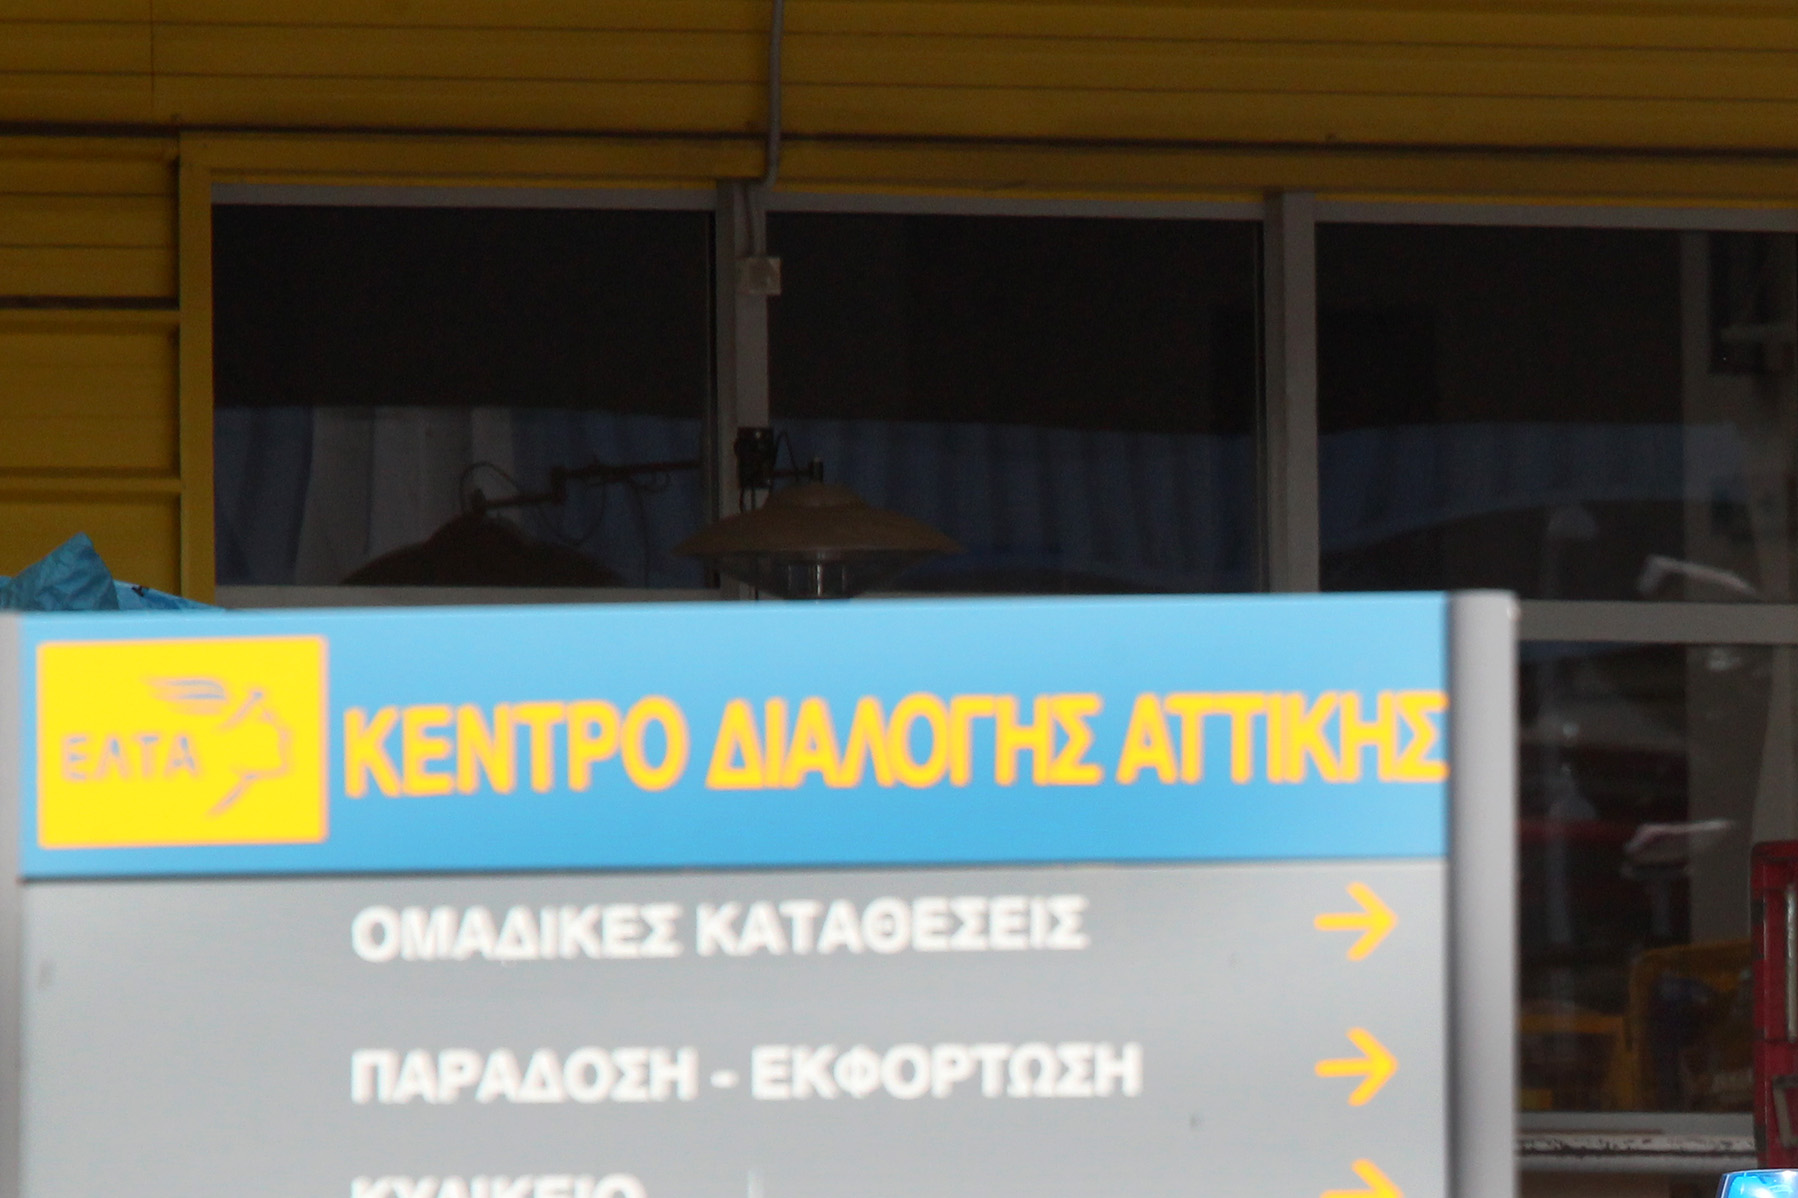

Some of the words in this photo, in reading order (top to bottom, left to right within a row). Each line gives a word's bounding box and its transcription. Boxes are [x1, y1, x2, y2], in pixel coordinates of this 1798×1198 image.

[60, 732, 204, 784] ΕΛΤΑ
[343, 696, 691, 799] ΚΕΝΤΡΟ
[707, 694, 1104, 790] ΔΙΑΛΟΓΗΣ
[1116, 691, 1449, 785] ΑΤΤΙΚΗΣ
[354, 905, 679, 963] ΟΜΑΔΙΚΕΣ
[698, 897, 1087, 955] ΚΑΤΑΘΕΣΕΙΣ
[353, 1048, 697, 1104] ΠΑΡΑΔΟΣΗ
[753, 1044, 1141, 1101] ΕΚΦΟΡΤΩΣΗ
